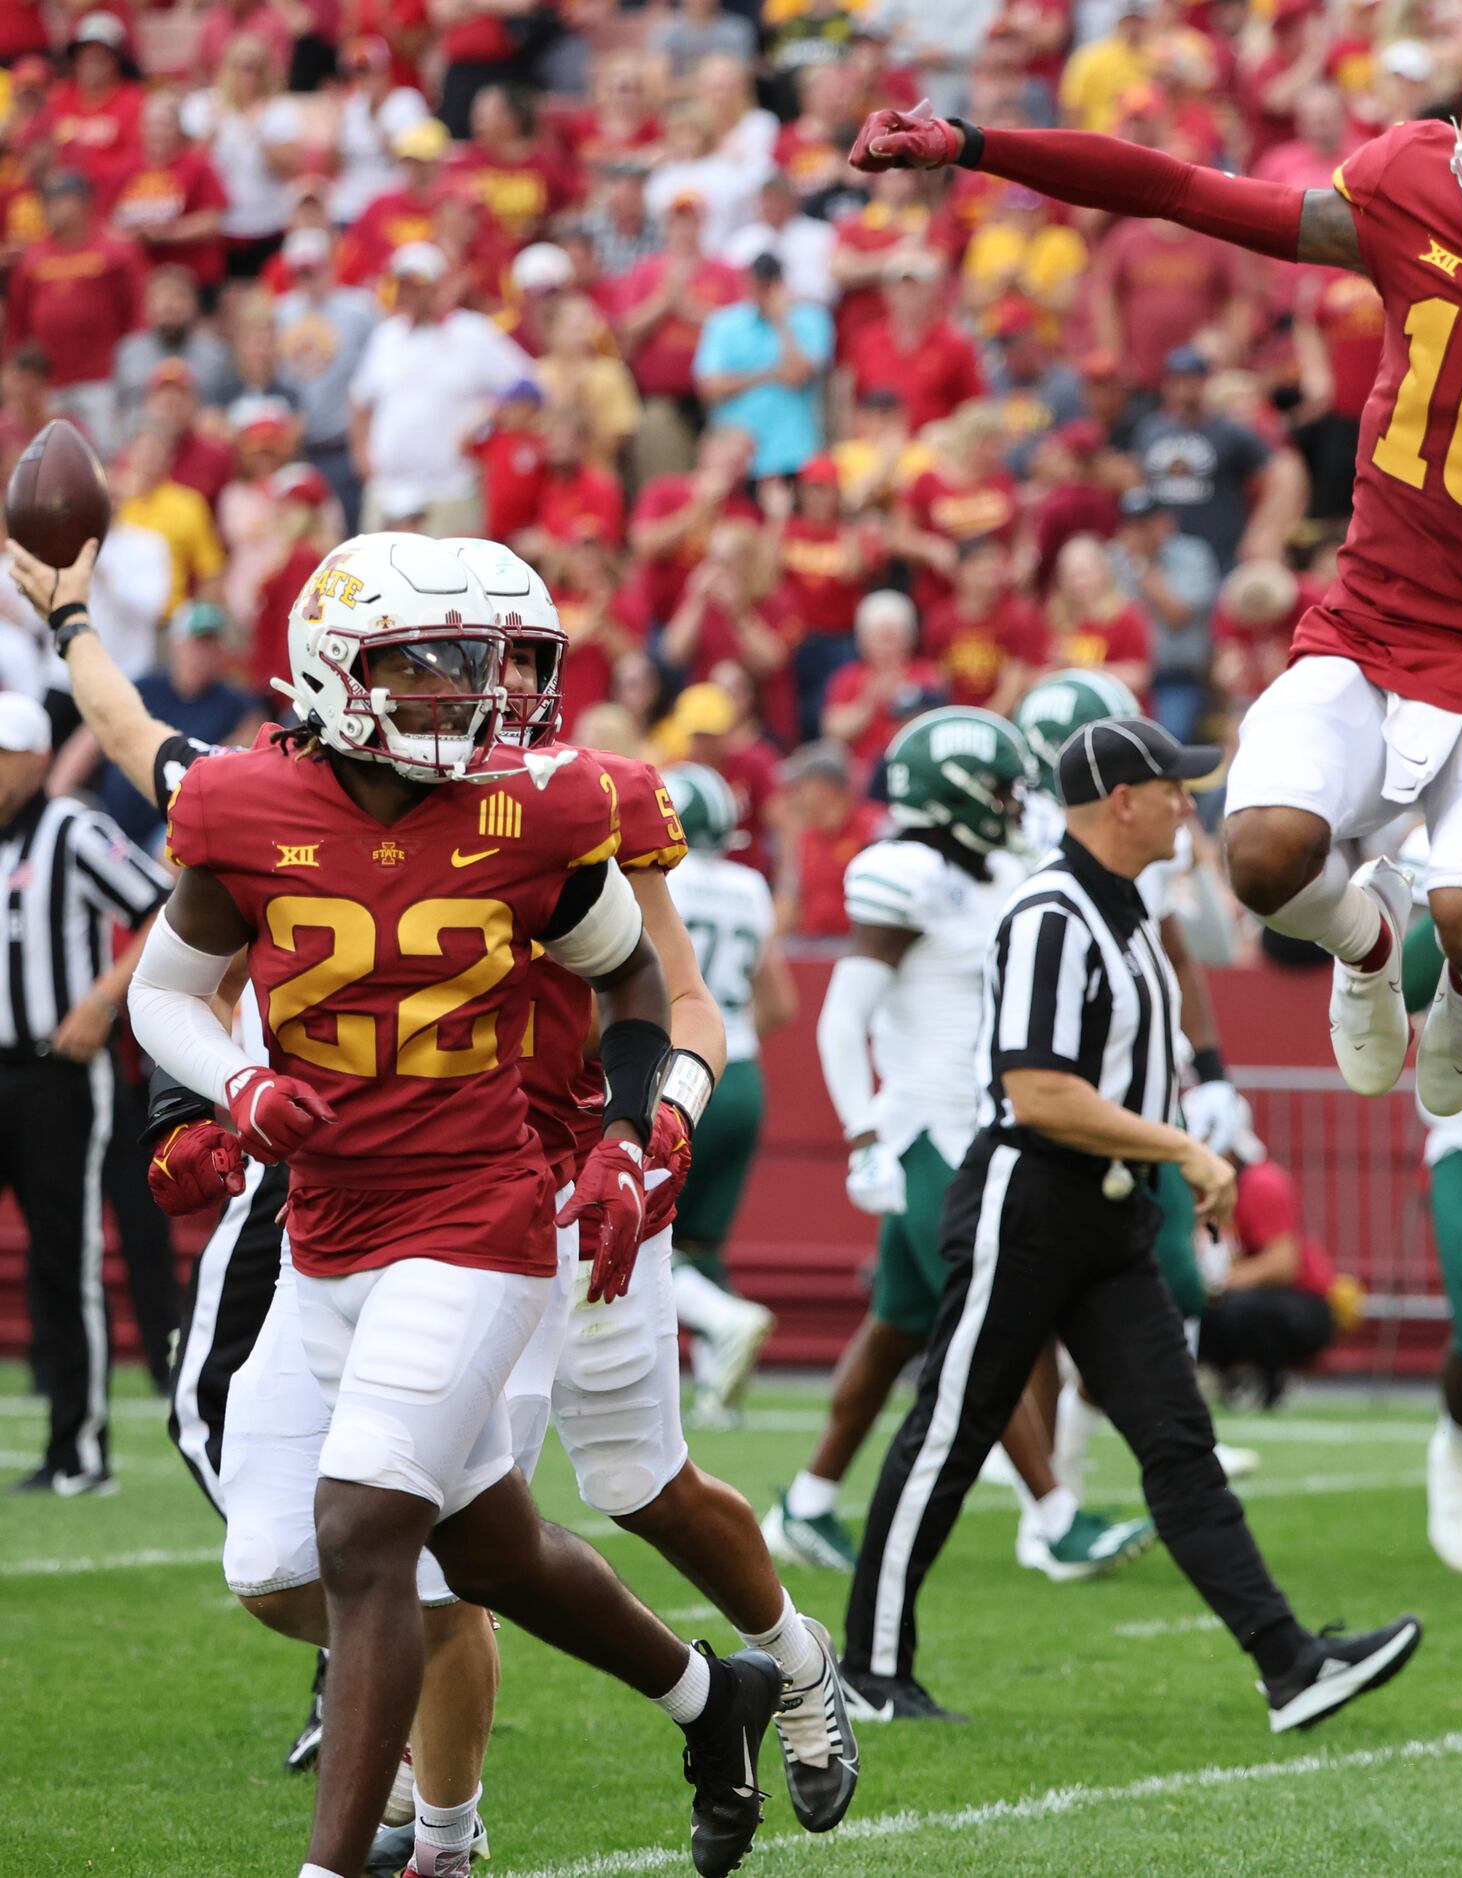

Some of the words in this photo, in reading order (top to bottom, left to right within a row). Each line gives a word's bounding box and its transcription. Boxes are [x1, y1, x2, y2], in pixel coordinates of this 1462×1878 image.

[310, 569, 364, 609] ATE
[599, 772, 620, 832] 2
[655, 787, 684, 841] 5
[276, 844, 320, 868] XII
[372, 849, 405, 860] STATE
[266, 896, 515, 1078] 22
